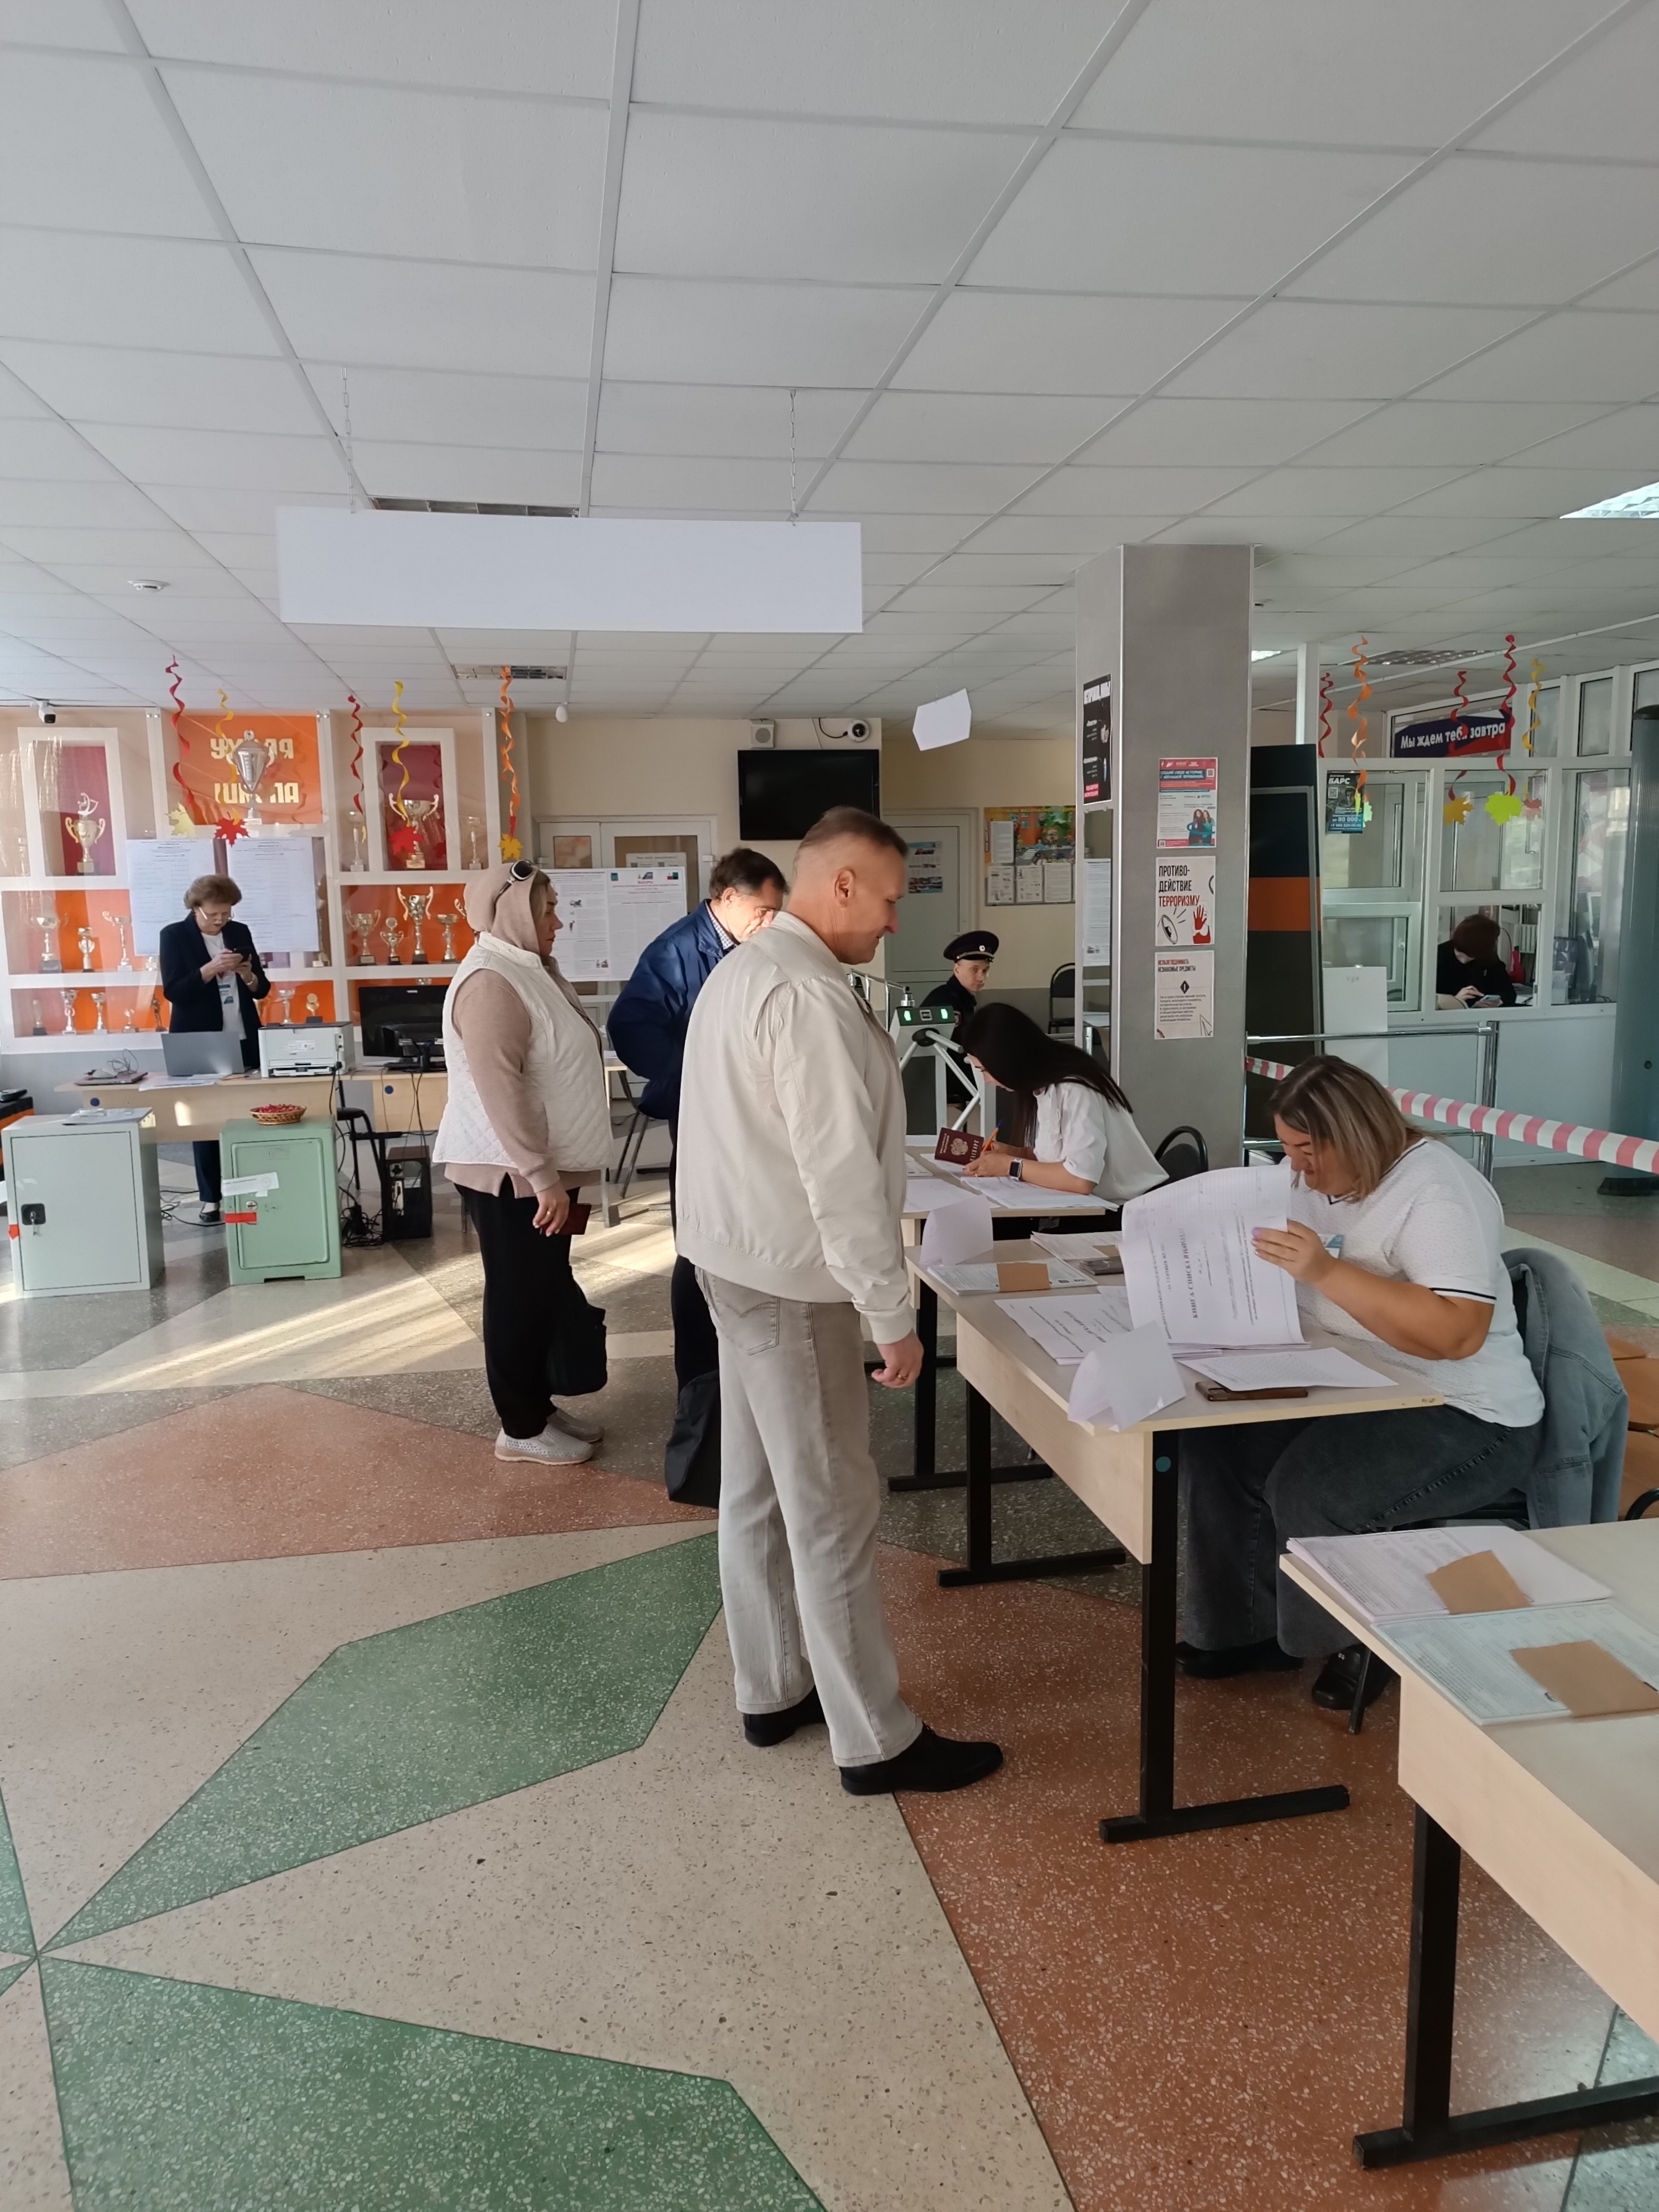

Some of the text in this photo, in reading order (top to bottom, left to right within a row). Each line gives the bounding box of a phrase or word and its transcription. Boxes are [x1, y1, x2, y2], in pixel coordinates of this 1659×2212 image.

[1401, 722, 1506, 749] Мы ждем теб завтра
[1159, 865, 1190, 877] ПРОТИВО-
[1159, 879, 1192, 893] ДЕЙСТВИЕ
[1159, 895, 1200, 907] ТЕРРОРИЗМУ
